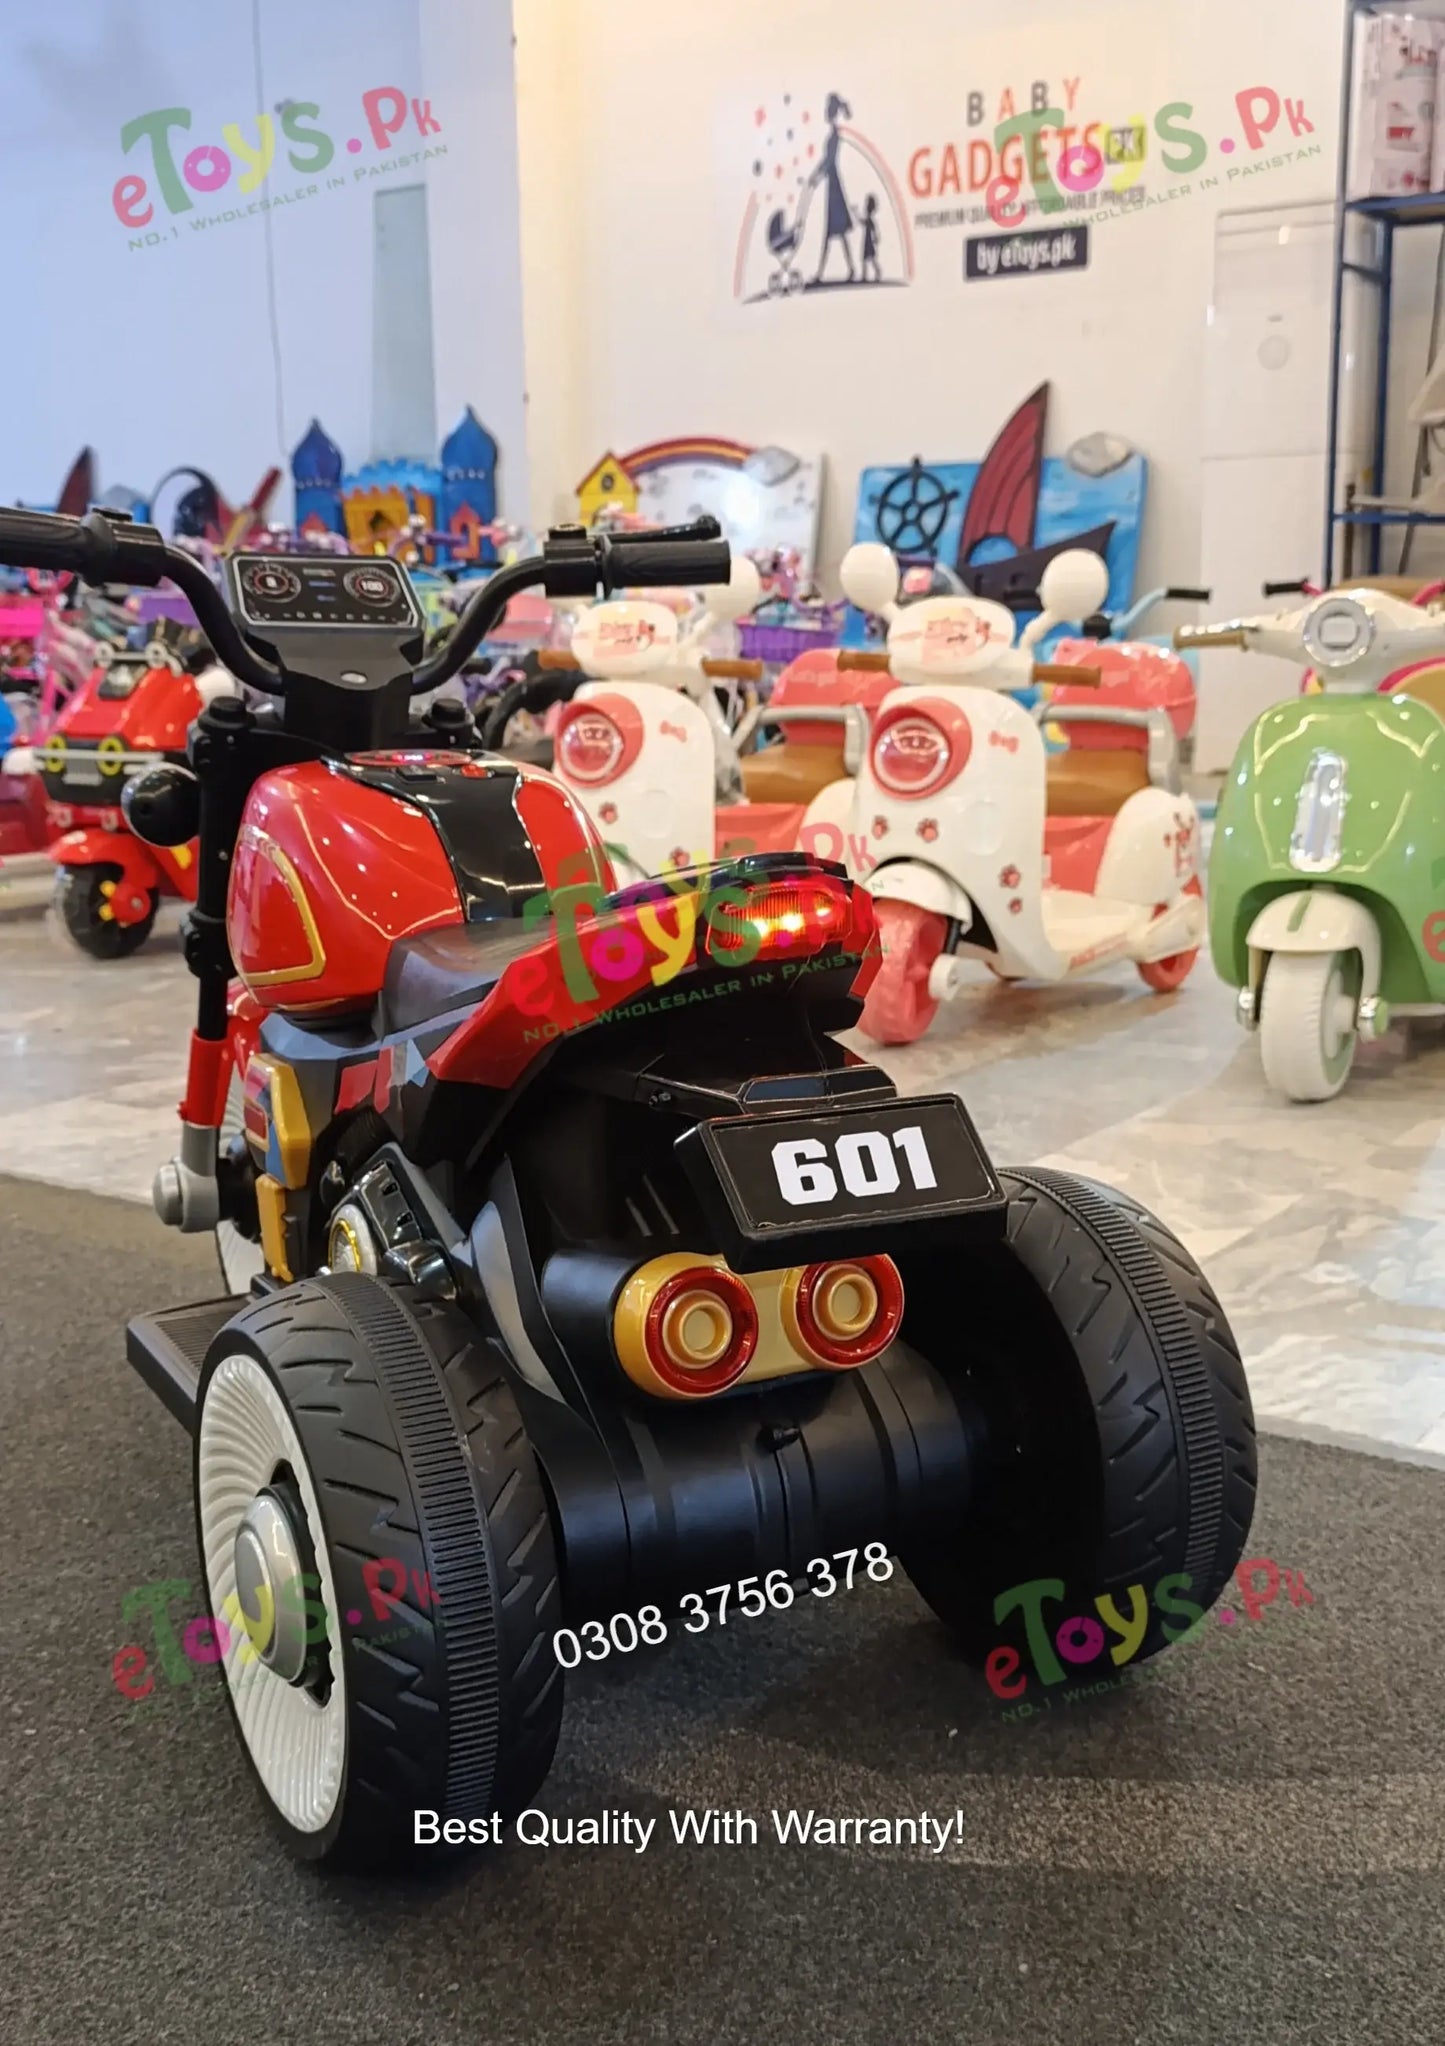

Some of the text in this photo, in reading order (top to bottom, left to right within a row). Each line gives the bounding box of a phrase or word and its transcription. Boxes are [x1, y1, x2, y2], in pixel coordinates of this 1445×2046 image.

[967, 76, 1081, 127] BABY
[908, 122, 1103, 198] GADGETS
[771, 1126, 938, 1205] 601
